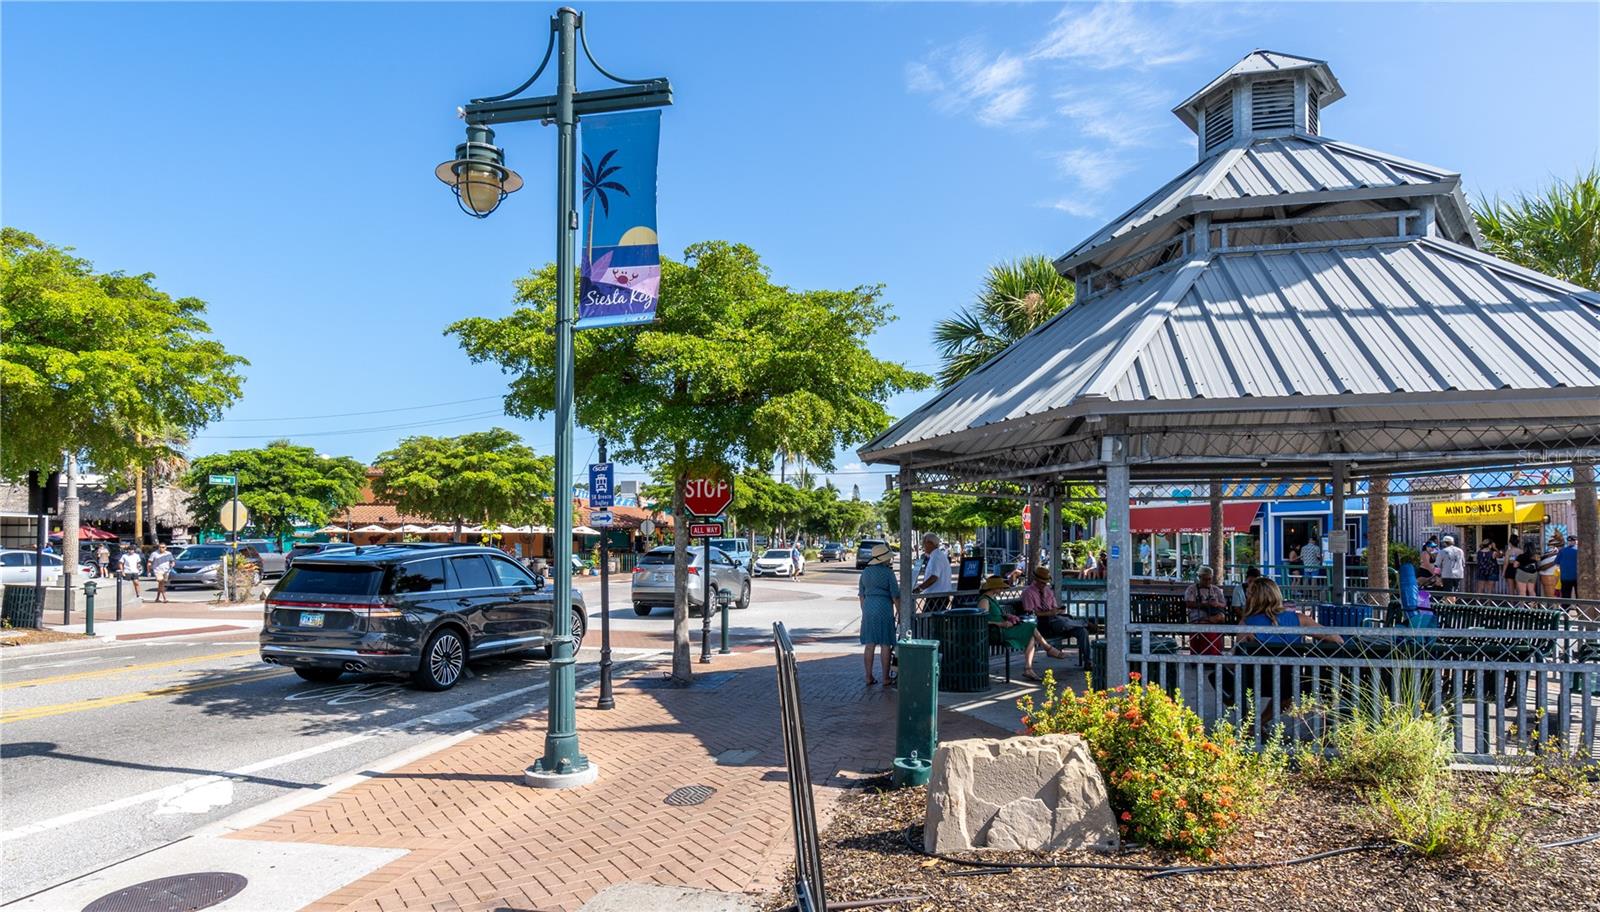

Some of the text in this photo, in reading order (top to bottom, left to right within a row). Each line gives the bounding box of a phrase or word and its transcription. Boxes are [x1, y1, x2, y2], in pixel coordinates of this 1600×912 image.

[585, 288, 653, 310] Siesta Key
[685, 478, 728, 498] STOP
[1445, 503, 1503, 514] MINI DONUTS
